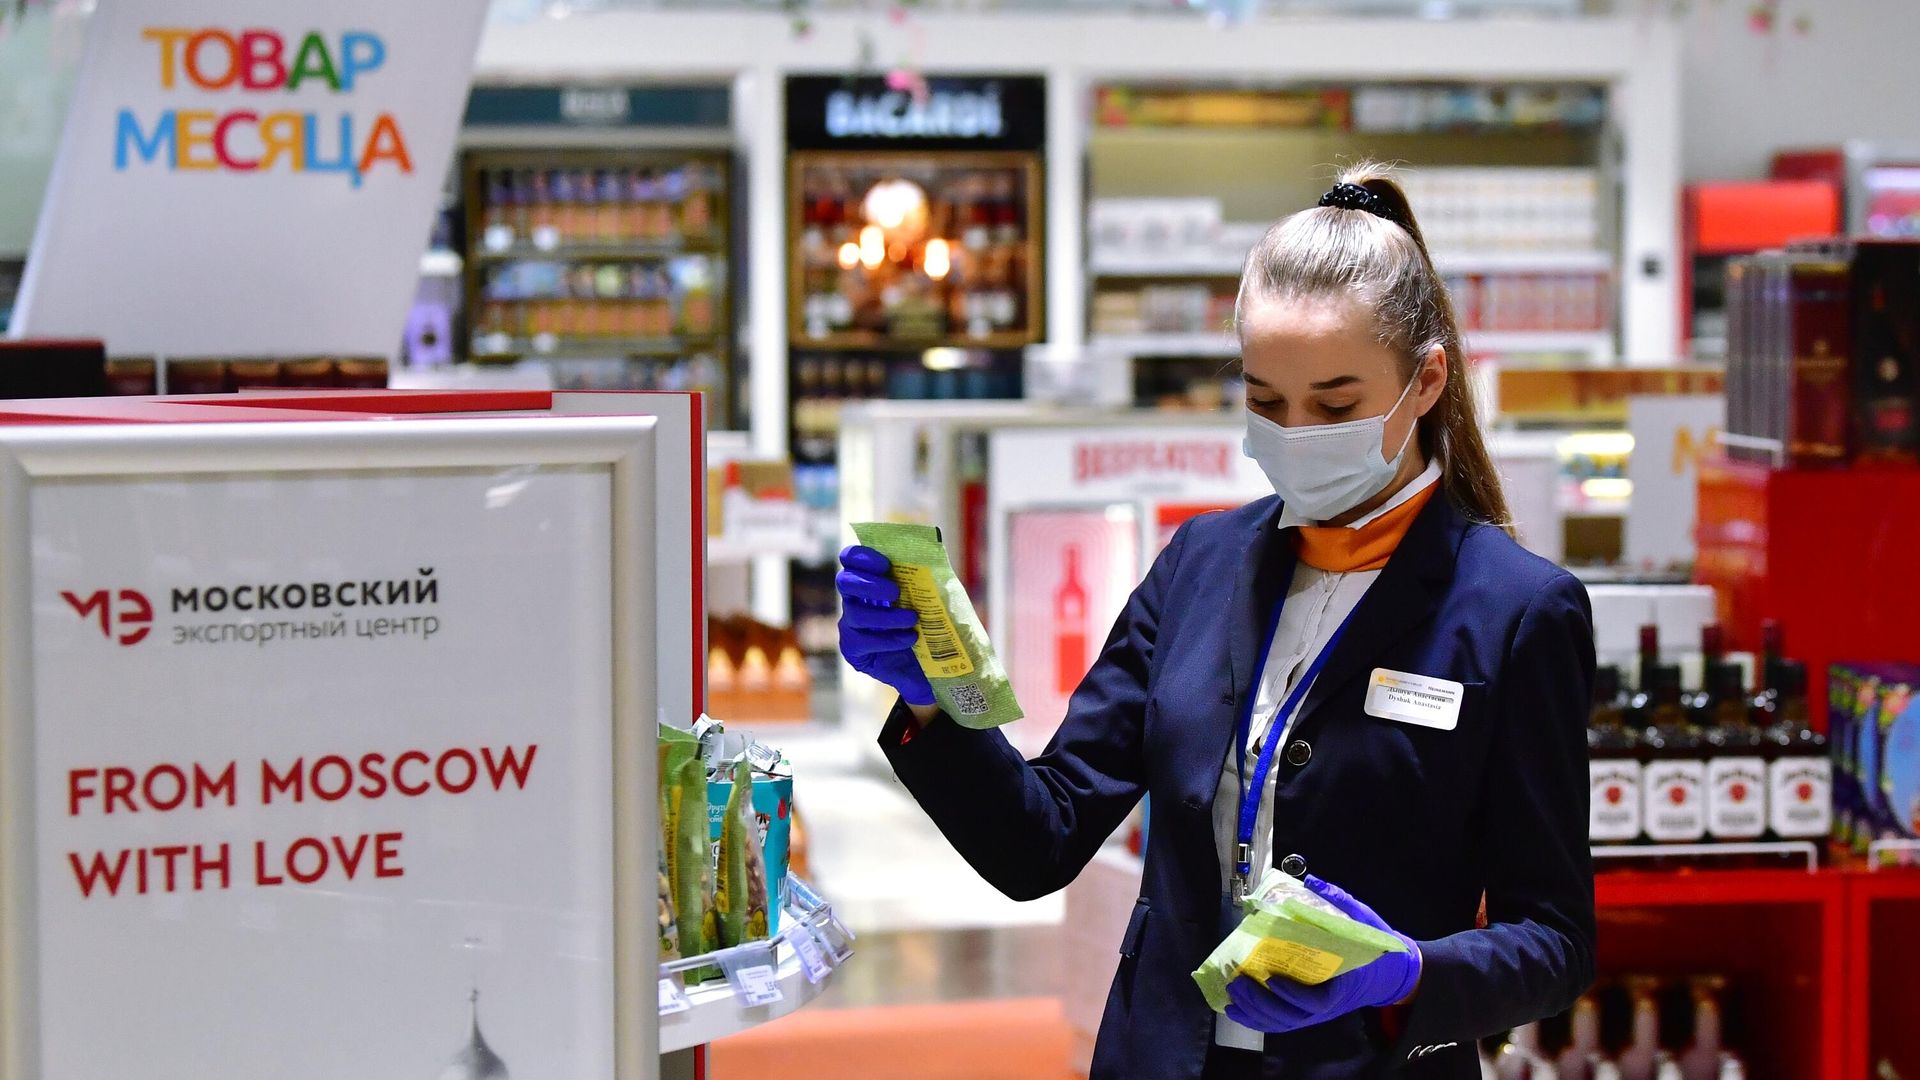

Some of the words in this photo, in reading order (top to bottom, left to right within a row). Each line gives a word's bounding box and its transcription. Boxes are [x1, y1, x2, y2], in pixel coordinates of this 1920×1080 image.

[142, 26, 386, 93] ТОВАР
[114, 108, 413, 189] МЕСЯЦА
[172, 568, 438, 613] МОСКОВСКИЙ
[173, 612, 346, 647] экспортный
[356, 612, 440, 641] центр
[68, 759, 237, 816] FROM
[261, 744, 538, 805] MOSCOW
[68, 843, 230, 900] WITH
[255, 832, 404, 887] LOVE
